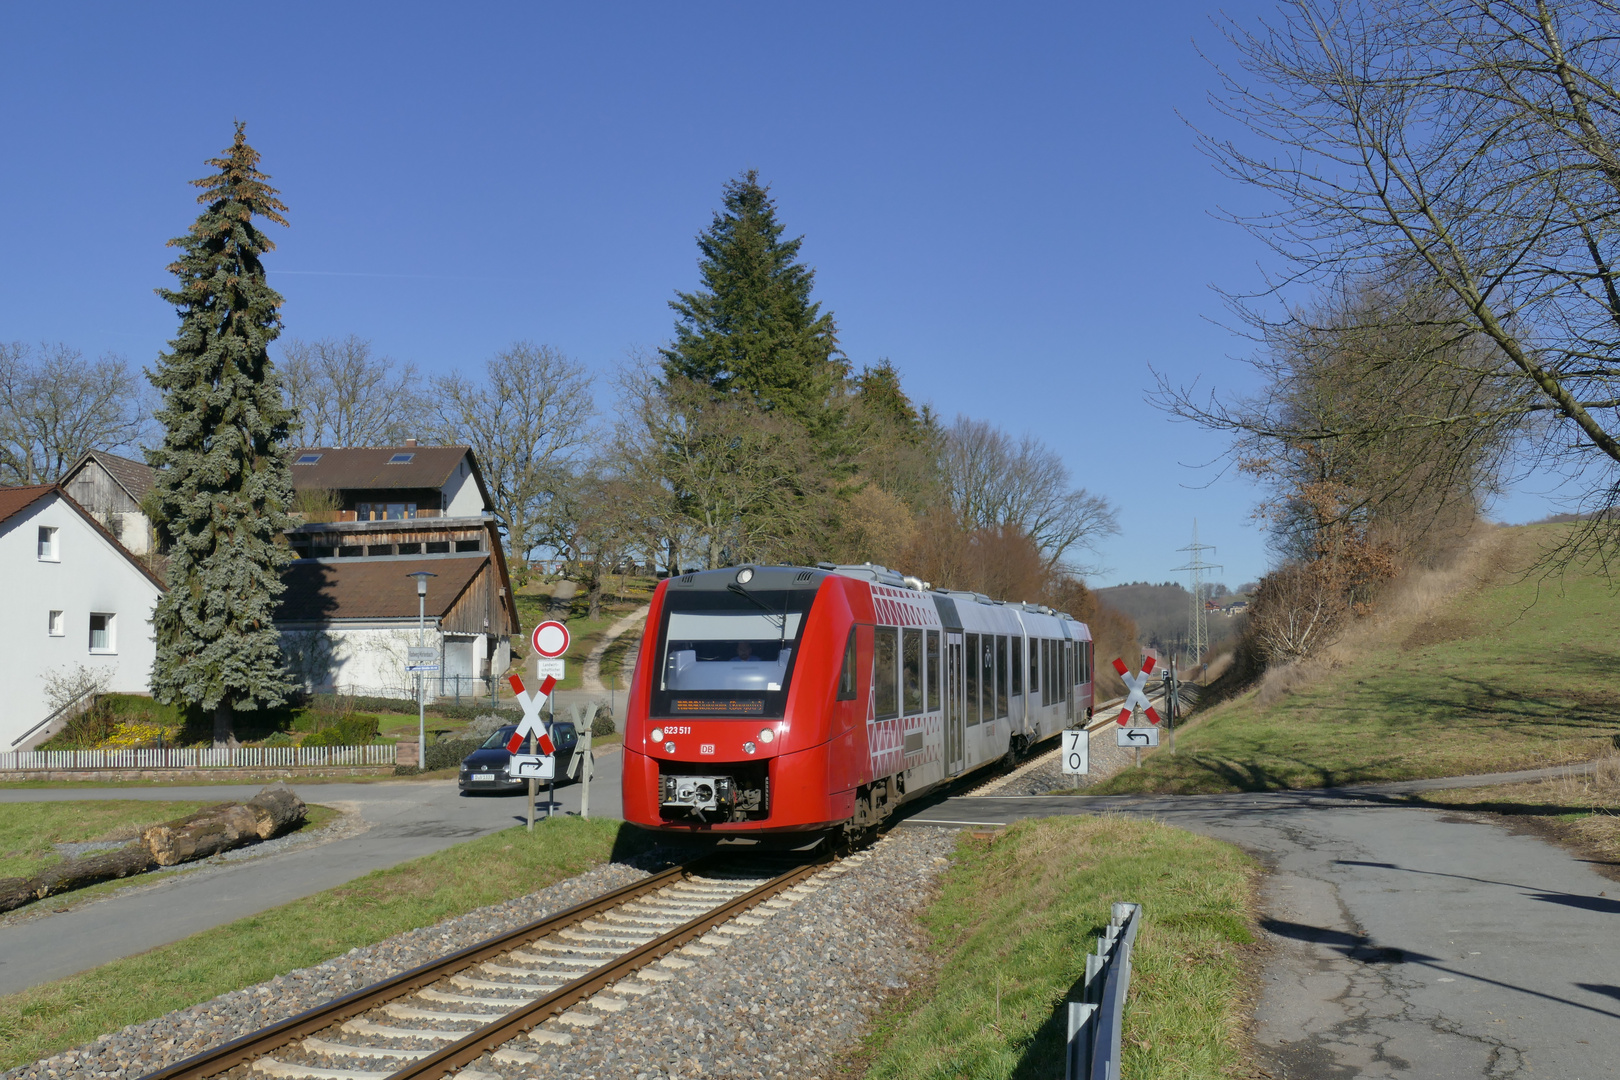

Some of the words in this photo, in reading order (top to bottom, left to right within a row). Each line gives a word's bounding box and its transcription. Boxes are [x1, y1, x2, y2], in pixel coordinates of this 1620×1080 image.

[1162, 670, 1168, 679] P
[664, 726, 678, 734] 623
[679, 726, 691, 734] 511
